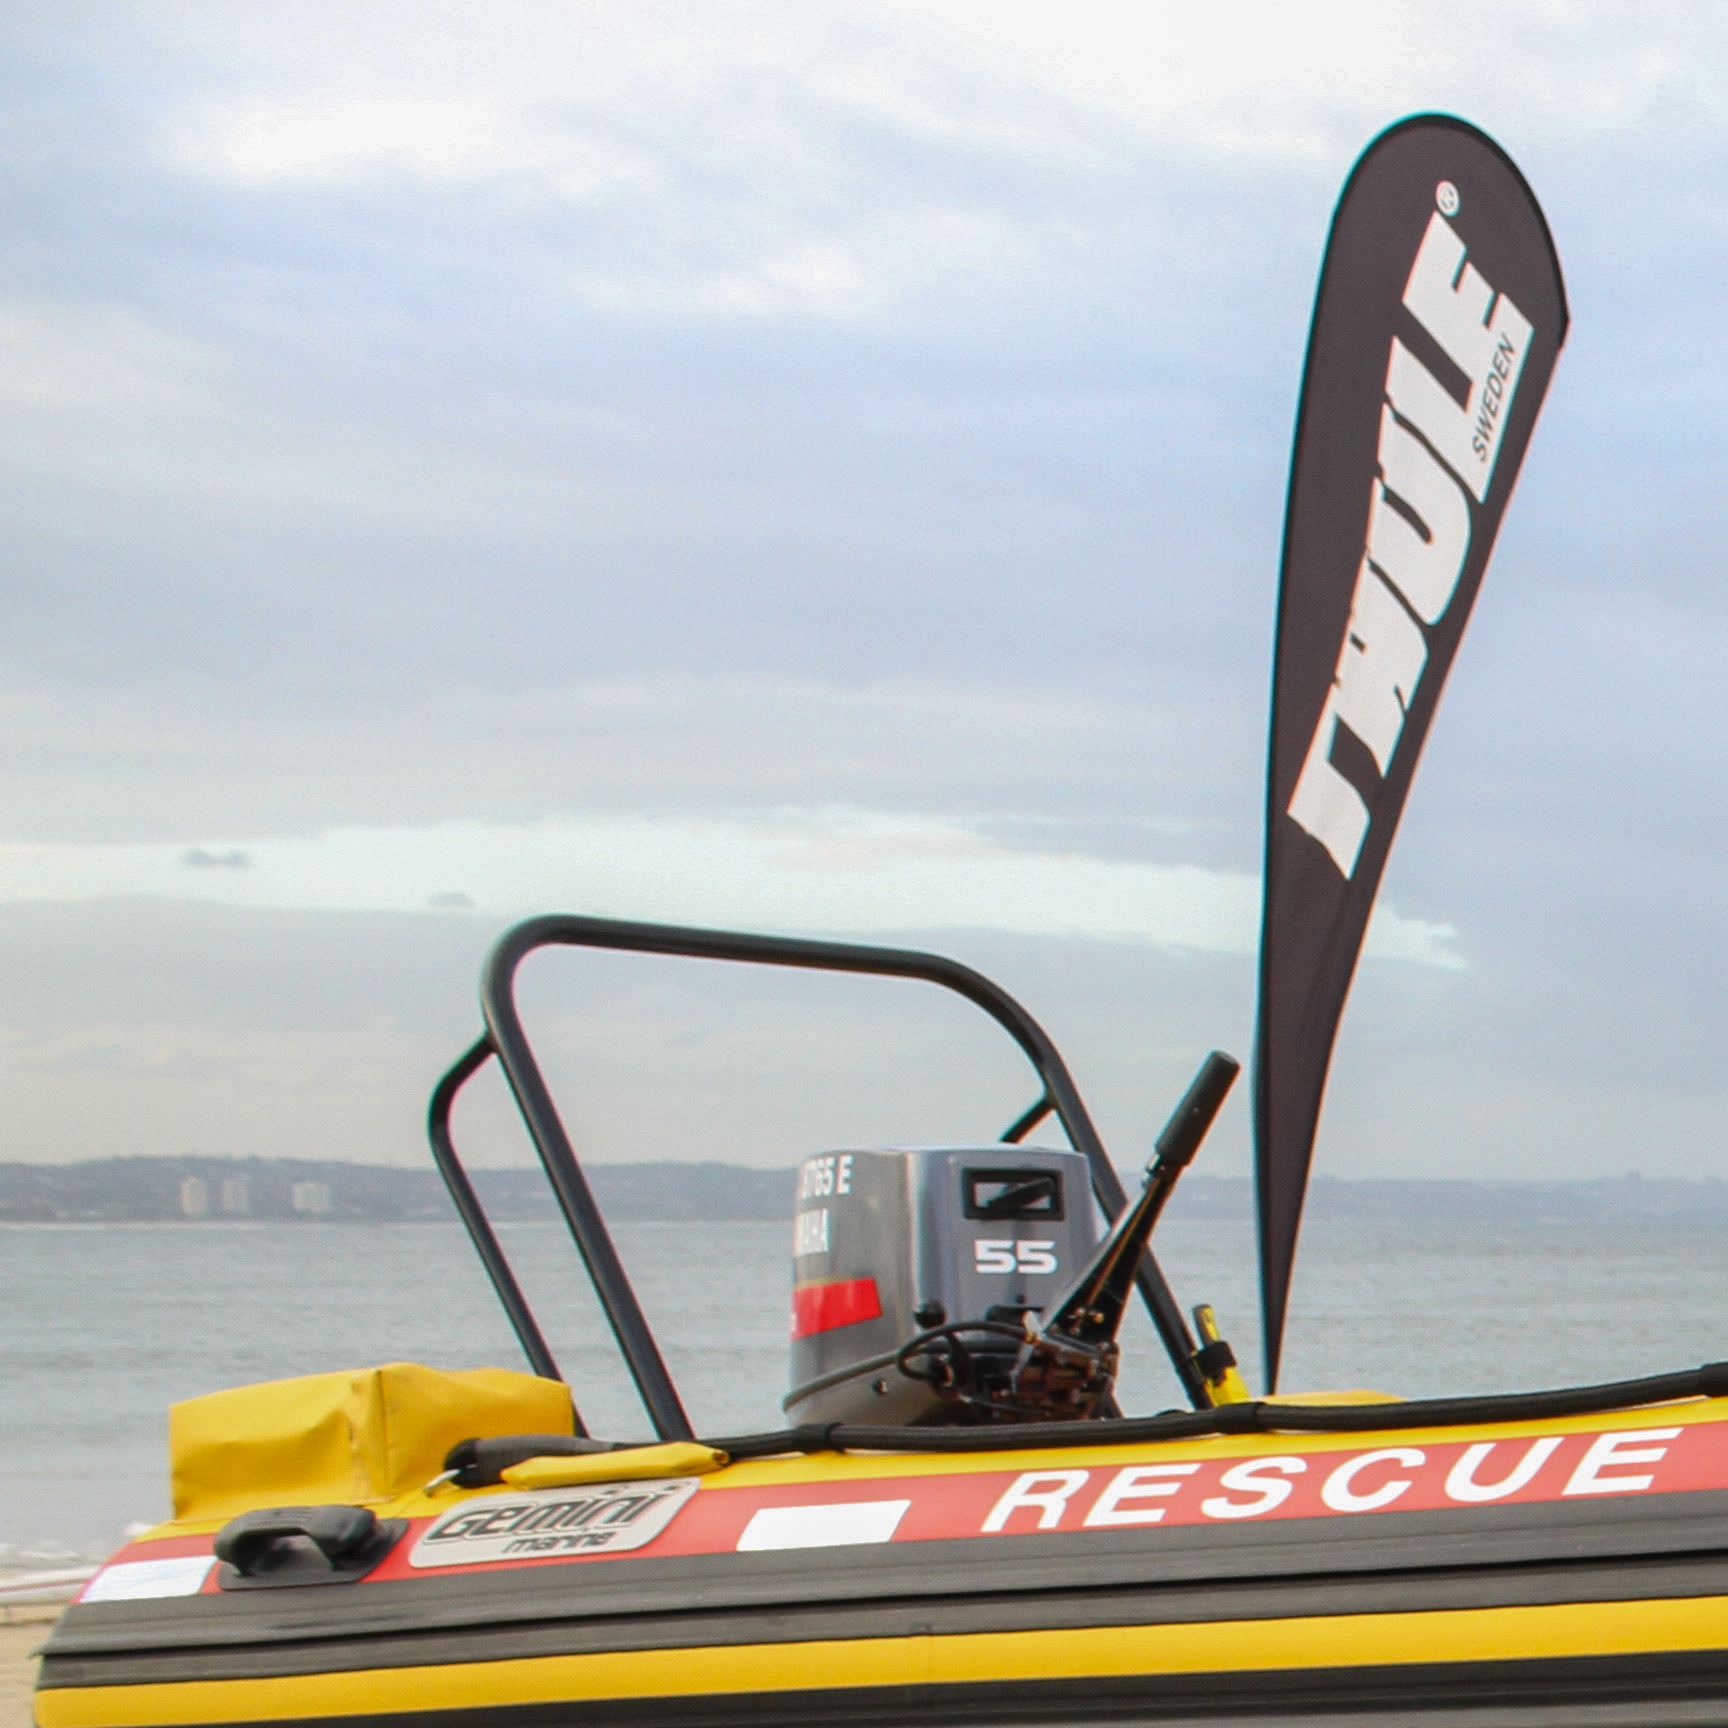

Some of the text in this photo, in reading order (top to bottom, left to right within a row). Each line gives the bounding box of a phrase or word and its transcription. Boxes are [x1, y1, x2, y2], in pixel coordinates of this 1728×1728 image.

[1470, 331, 1518, 464] SWEDEN
[973, 1239, 1058, 1275] 55
[979, 1426, 1684, 1534] RESCUE
